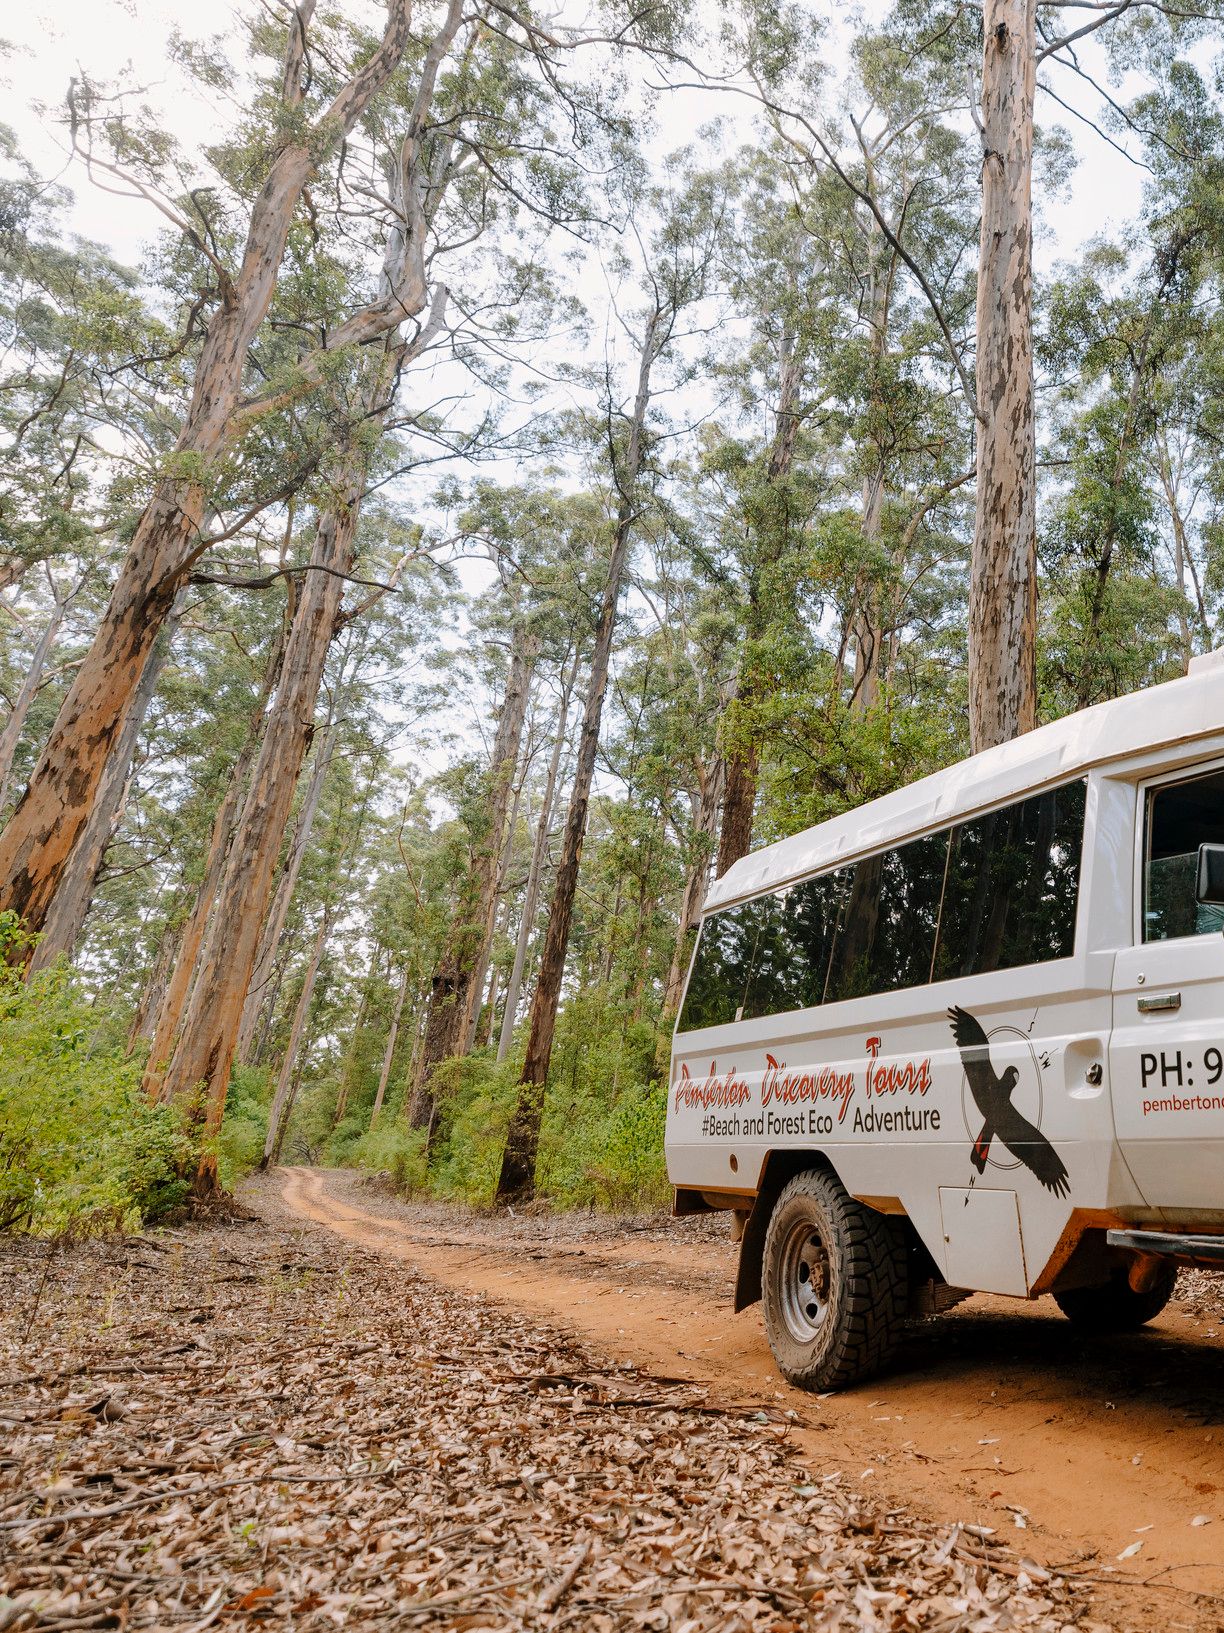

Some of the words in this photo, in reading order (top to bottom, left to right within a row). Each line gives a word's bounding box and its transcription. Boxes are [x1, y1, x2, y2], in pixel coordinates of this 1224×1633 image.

[675, 1060, 751, 1114] Pemberton
[762, 1053, 855, 1124] Discovery
[866, 1036, 932, 1099] Tours
[1140, 1051, 1195, 1088] PH:
[702, 1113, 740, 1137] #Beach
[742, 1111, 764, 1135] and
[767, 1112, 806, 1135] Forest
[809, 1109, 833, 1134] Eco
[853, 1105, 941, 1133] Adventure
